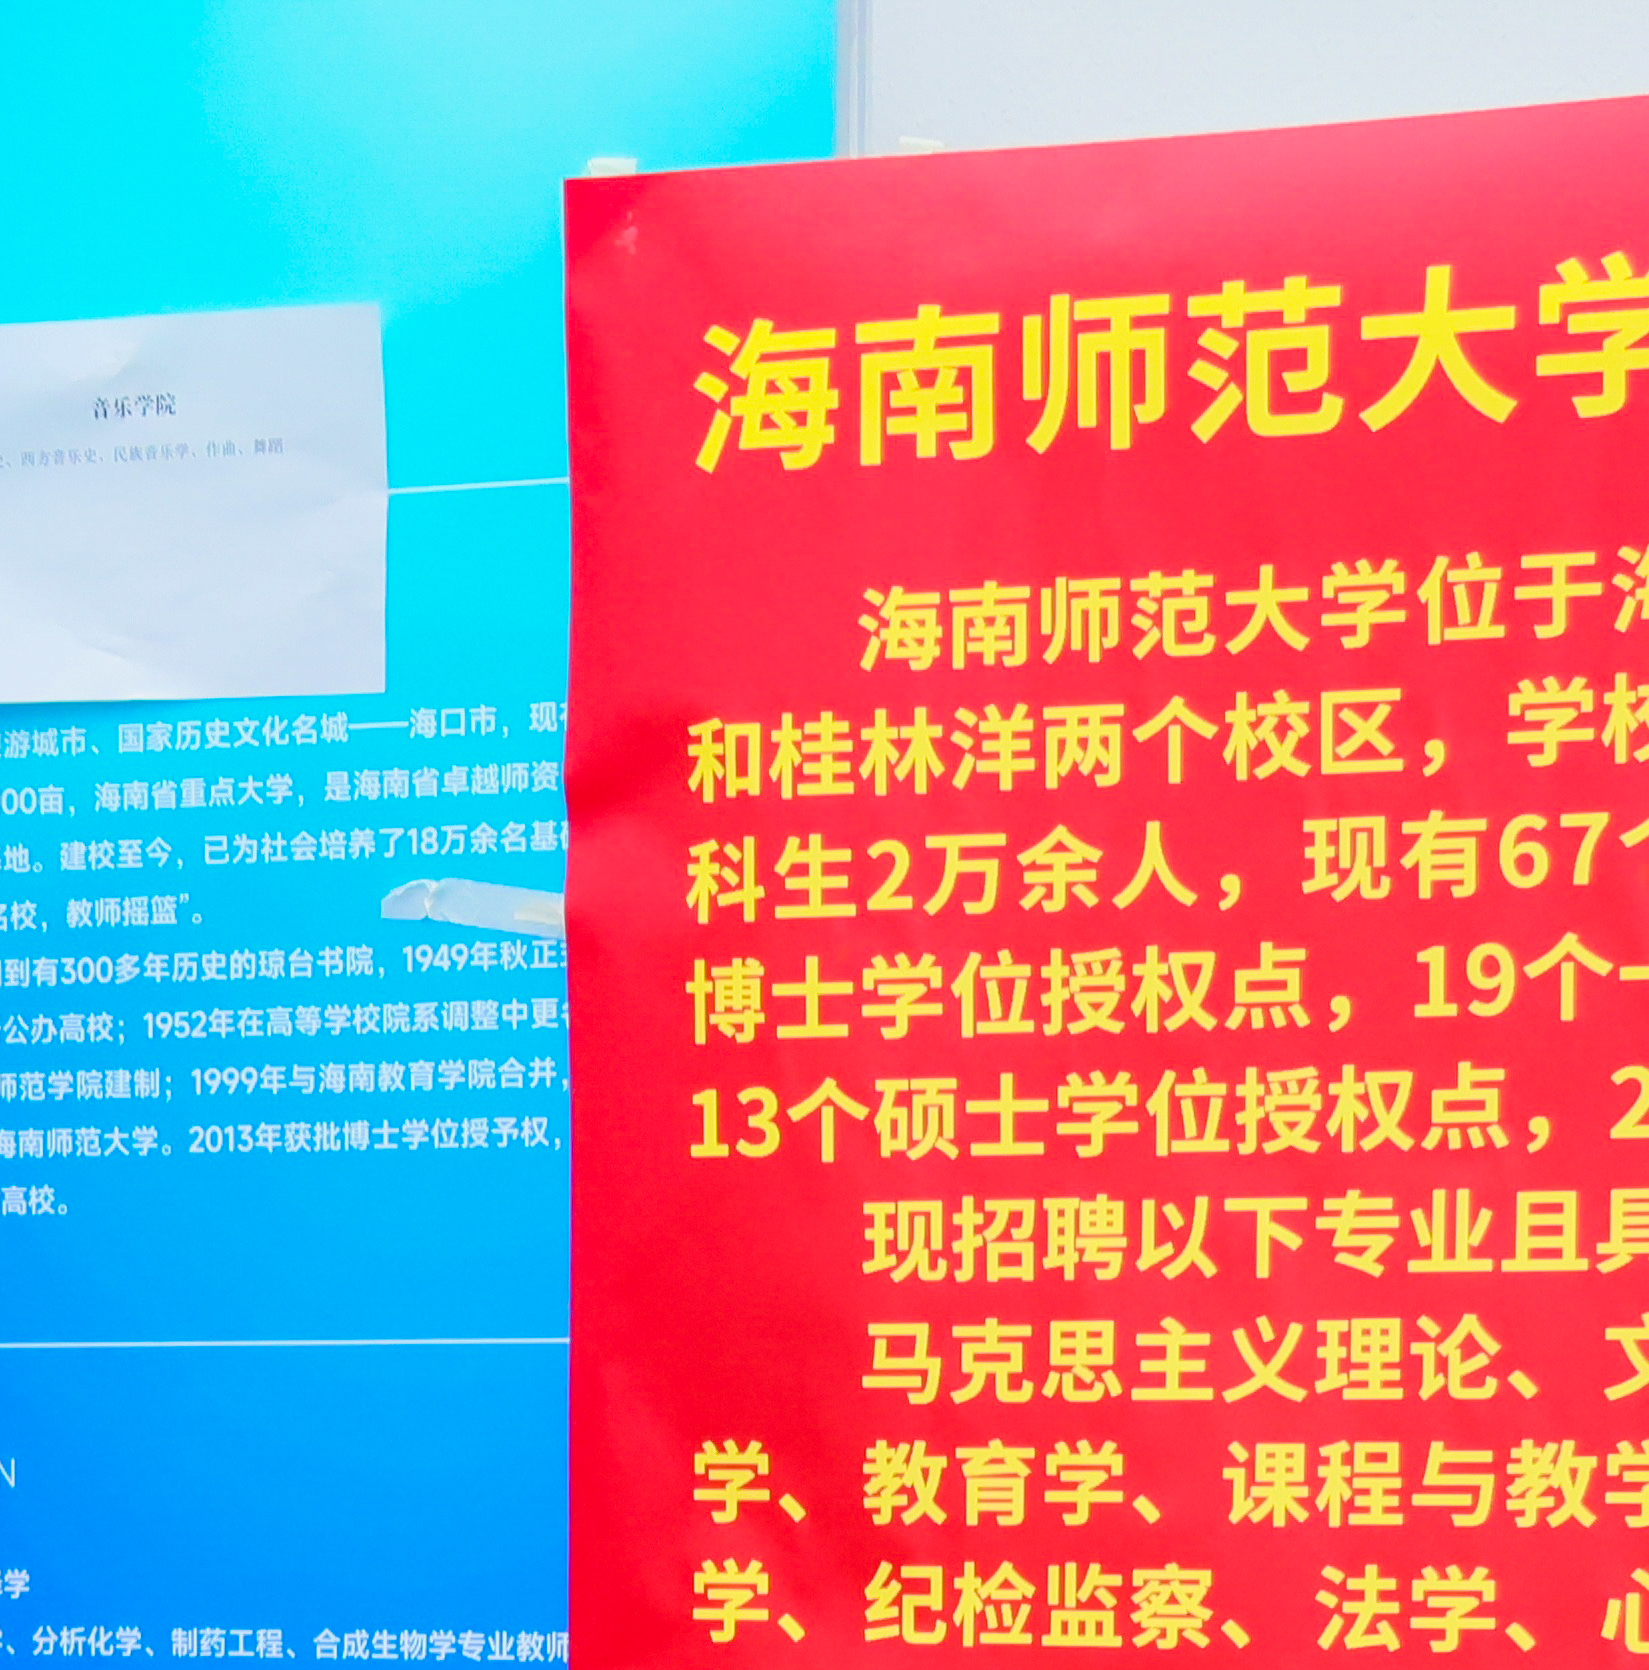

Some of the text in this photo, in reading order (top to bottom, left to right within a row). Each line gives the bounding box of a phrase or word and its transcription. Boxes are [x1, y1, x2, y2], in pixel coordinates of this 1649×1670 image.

[91, 391, 177, 421] 音乐学院
[694, 251, 1649, 473] 海南师范大学
[690, 1061, 1649, 1163] 13个硕士学位授权点，2
